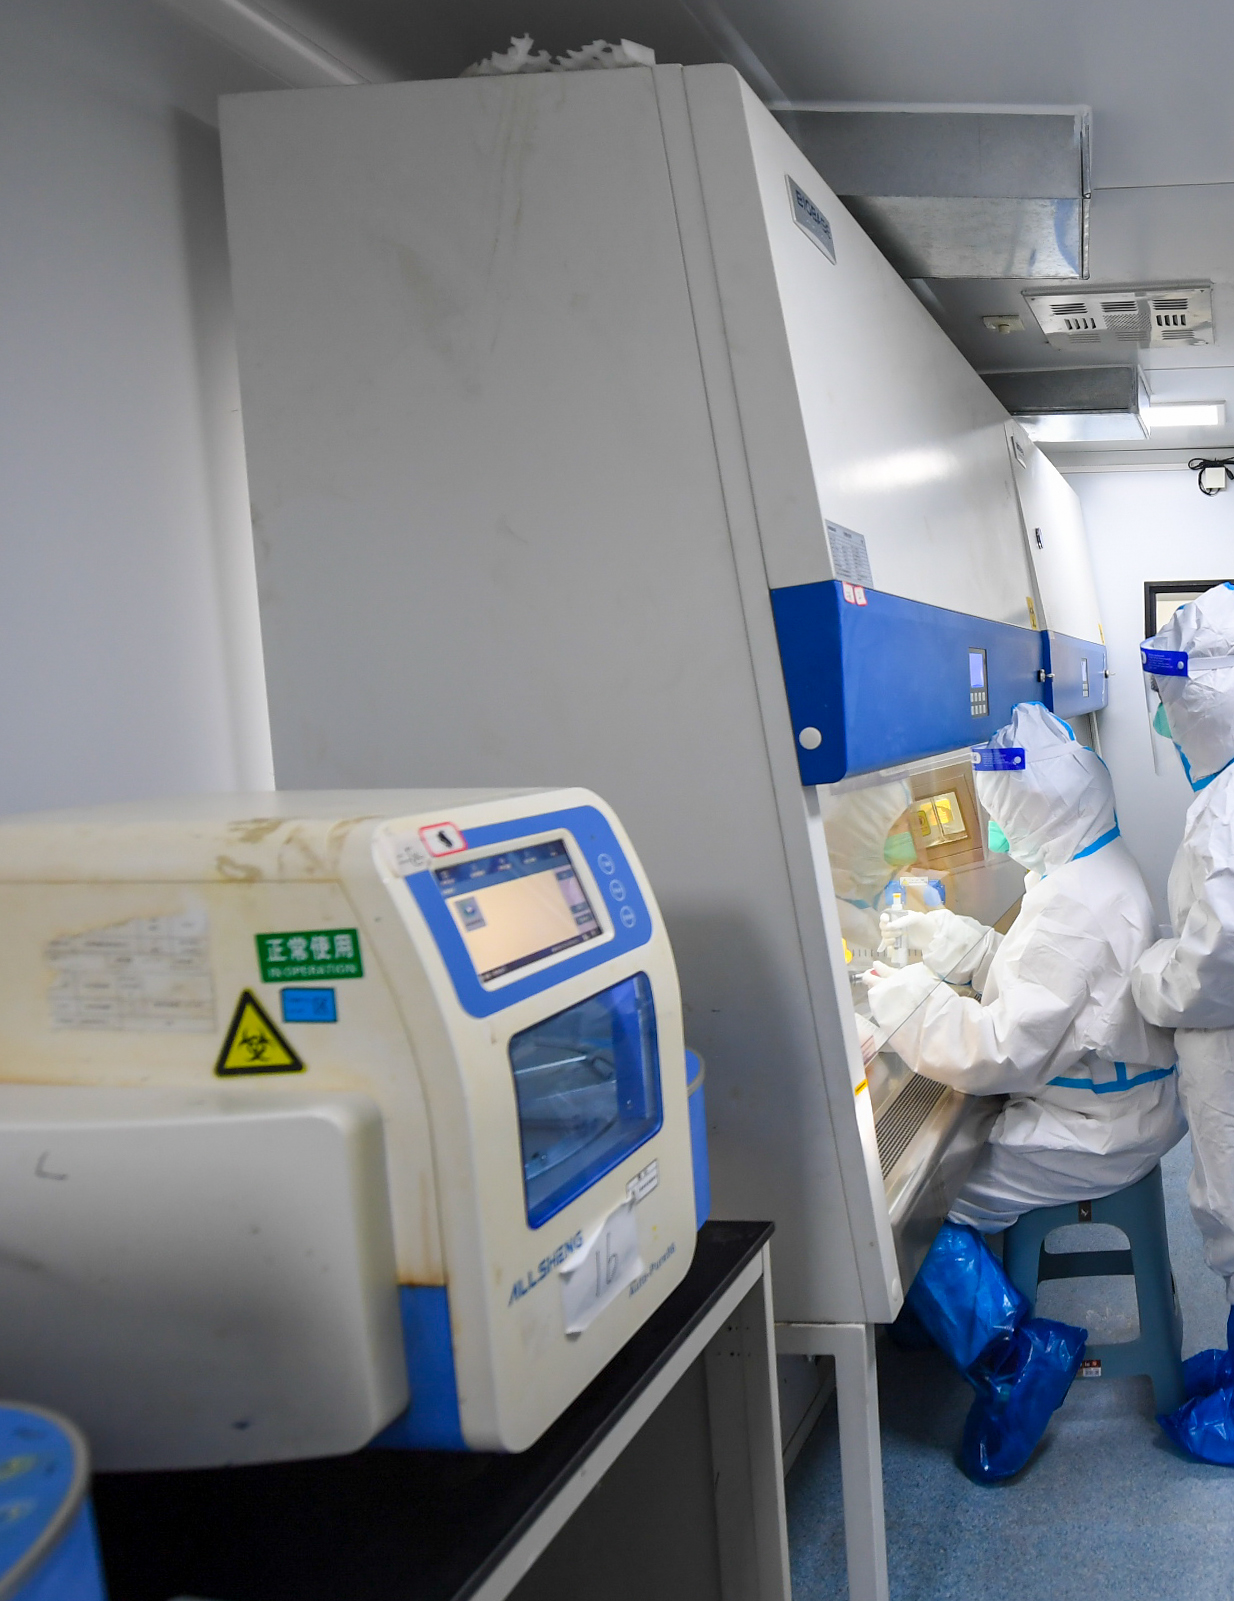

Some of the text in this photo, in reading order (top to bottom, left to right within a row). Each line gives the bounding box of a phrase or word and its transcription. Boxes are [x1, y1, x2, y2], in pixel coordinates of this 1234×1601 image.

[265, 933, 354, 962] 正常使用
[508, 1229, 583, 1307] ALLSHENG
